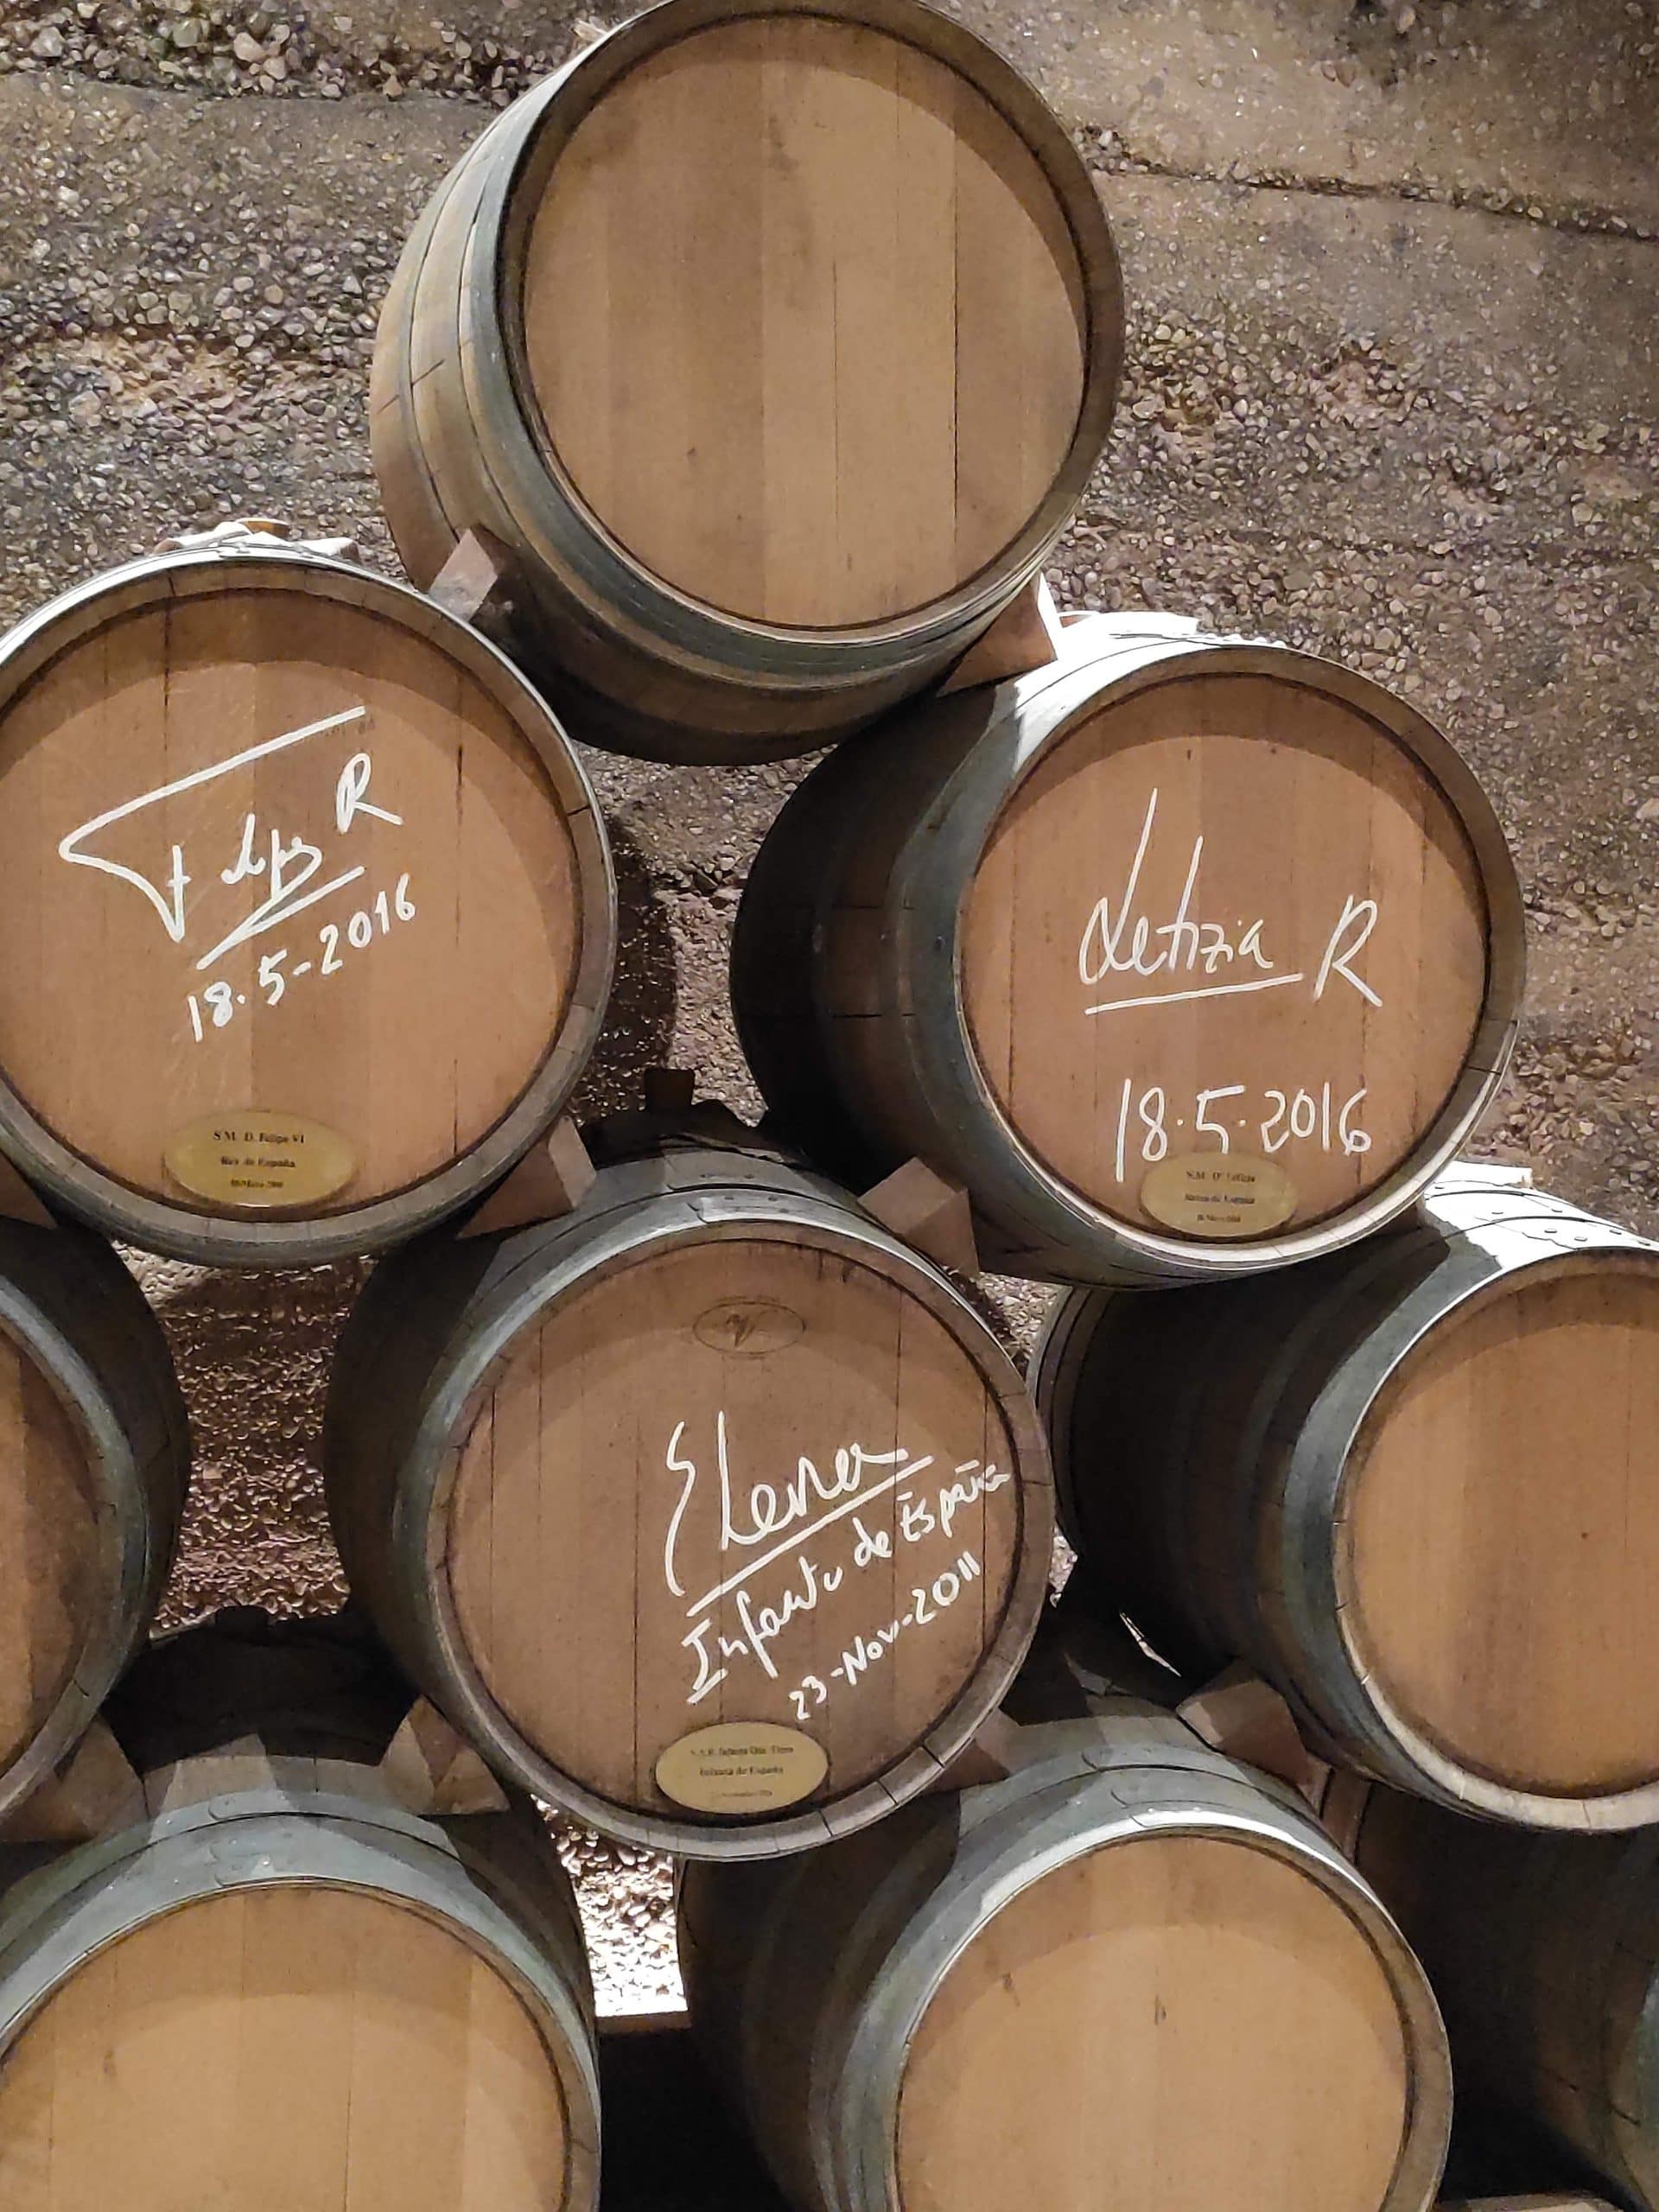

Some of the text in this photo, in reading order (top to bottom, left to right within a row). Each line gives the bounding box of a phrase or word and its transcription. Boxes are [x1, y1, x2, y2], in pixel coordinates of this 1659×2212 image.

[336, 753, 404, 834] R
[1078, 787, 1382, 1007] Letizia R
[853, 1516, 893, 1567] de
